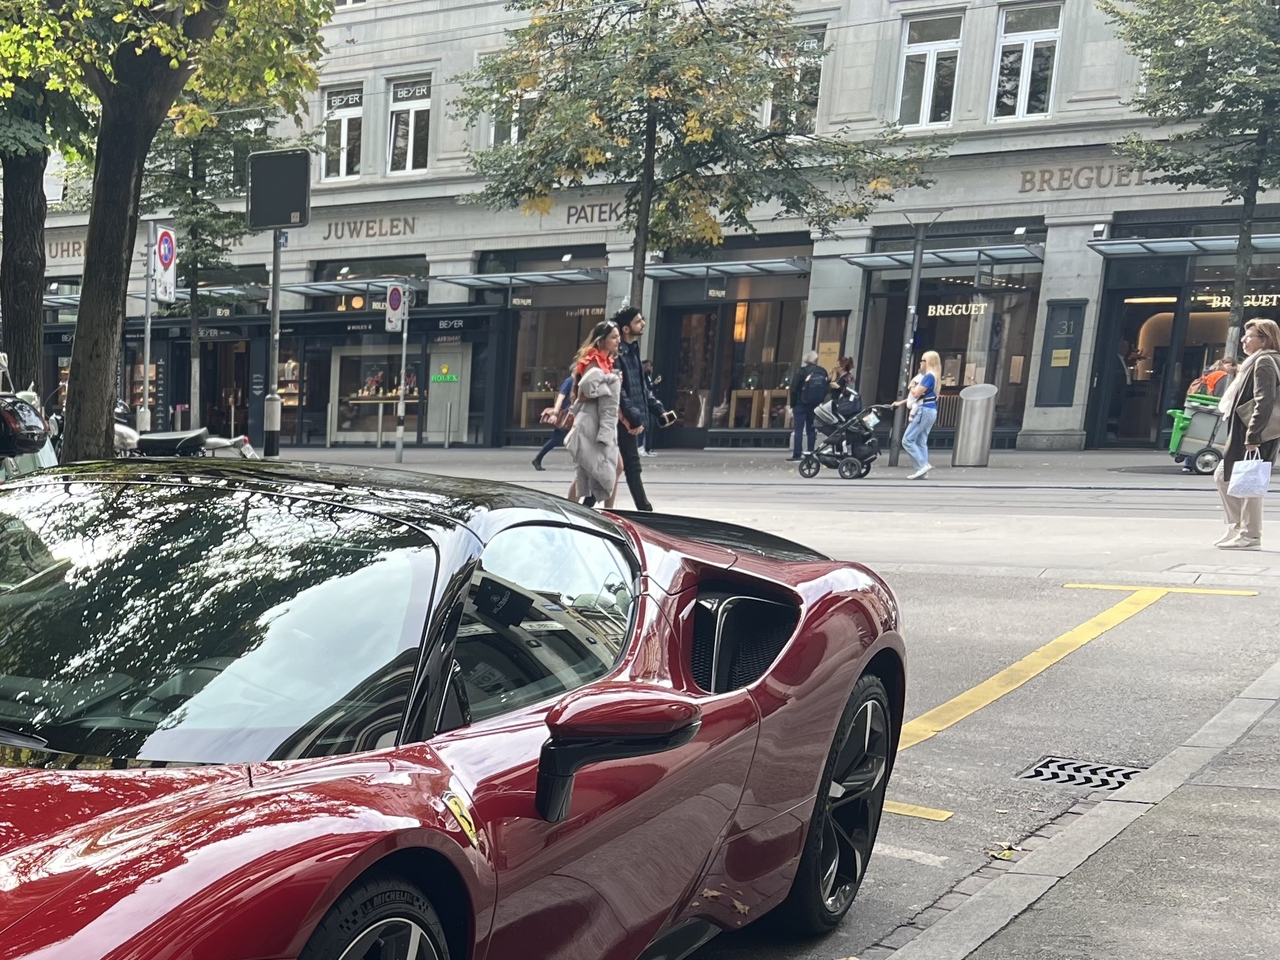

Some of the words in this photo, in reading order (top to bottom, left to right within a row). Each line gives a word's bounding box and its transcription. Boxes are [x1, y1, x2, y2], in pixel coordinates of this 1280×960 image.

[397, 86, 427, 98] BEYER
[331, 94, 360, 106] BEYER
[1018, 165, 1146, 193] BREGUET
[566, 202, 621, 225] PATEK
[323, 217, 416, 240] JUWELEN
[48, 241, 86, 259] UHR
[1211, 294, 1280, 308] BRGUET
[927, 303, 988, 316] BREGUET
[439, 320, 464, 328] BEYER
[1057, 320, 1074, 335] 31
[431, 374, 458, 382] ROLEX
